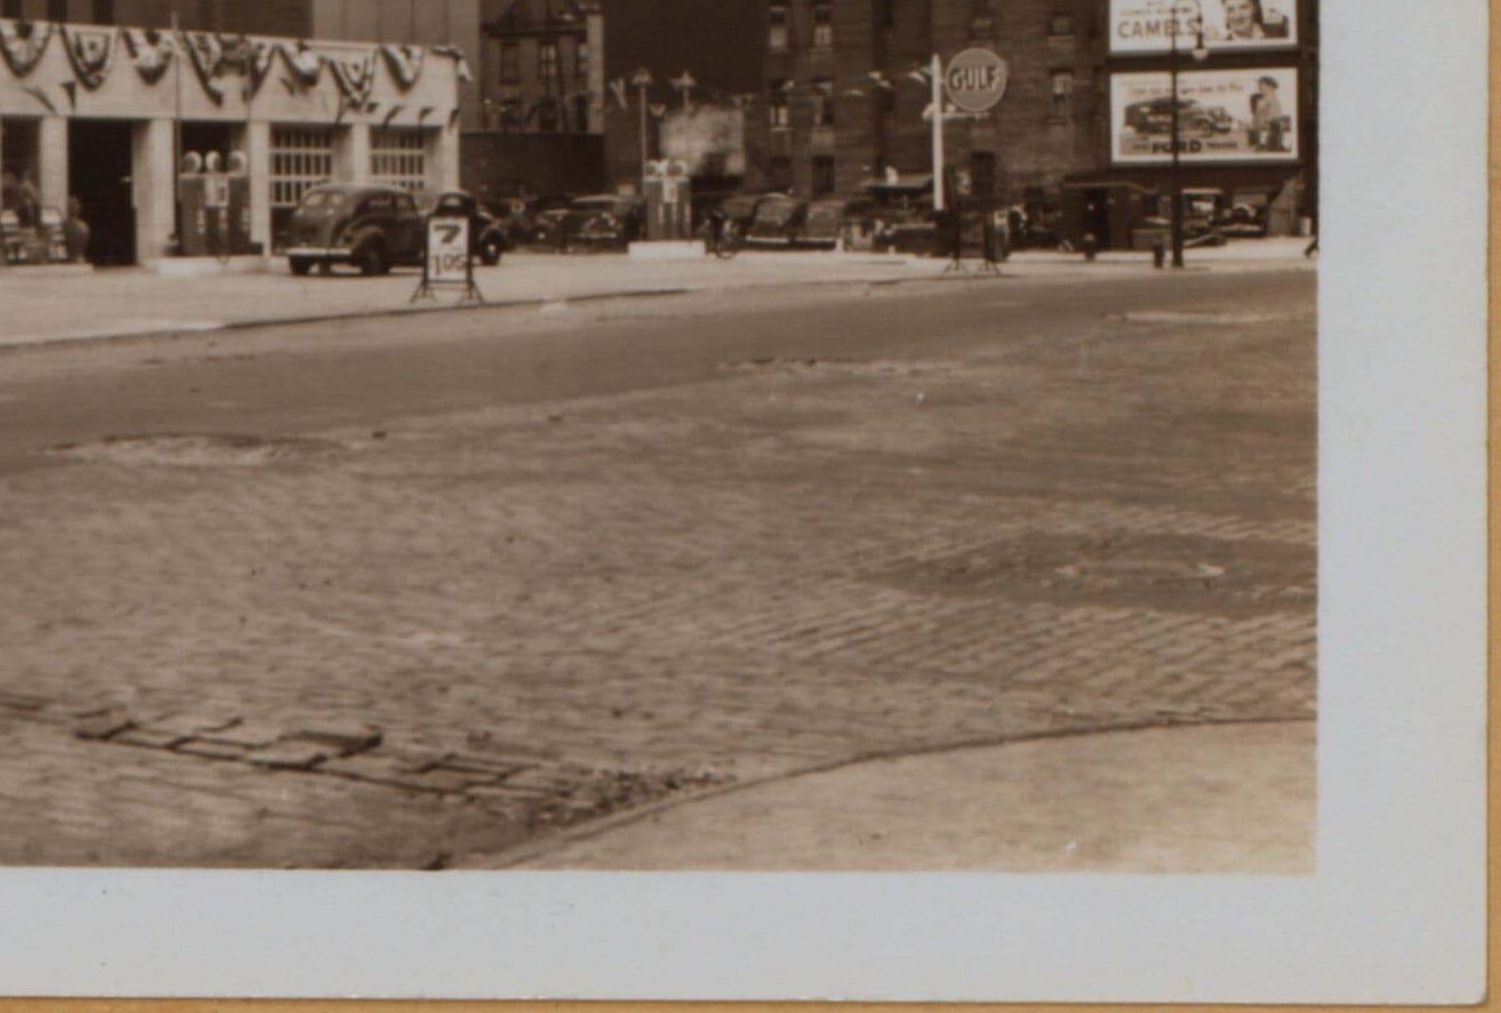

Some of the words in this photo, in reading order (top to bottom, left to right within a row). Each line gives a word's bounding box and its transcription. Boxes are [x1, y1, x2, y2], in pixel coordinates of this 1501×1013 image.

[1117, 18, 1199, 39] CAMELS
[949, 65, 998, 92] GULF
[434, 224, 461, 245] 7
